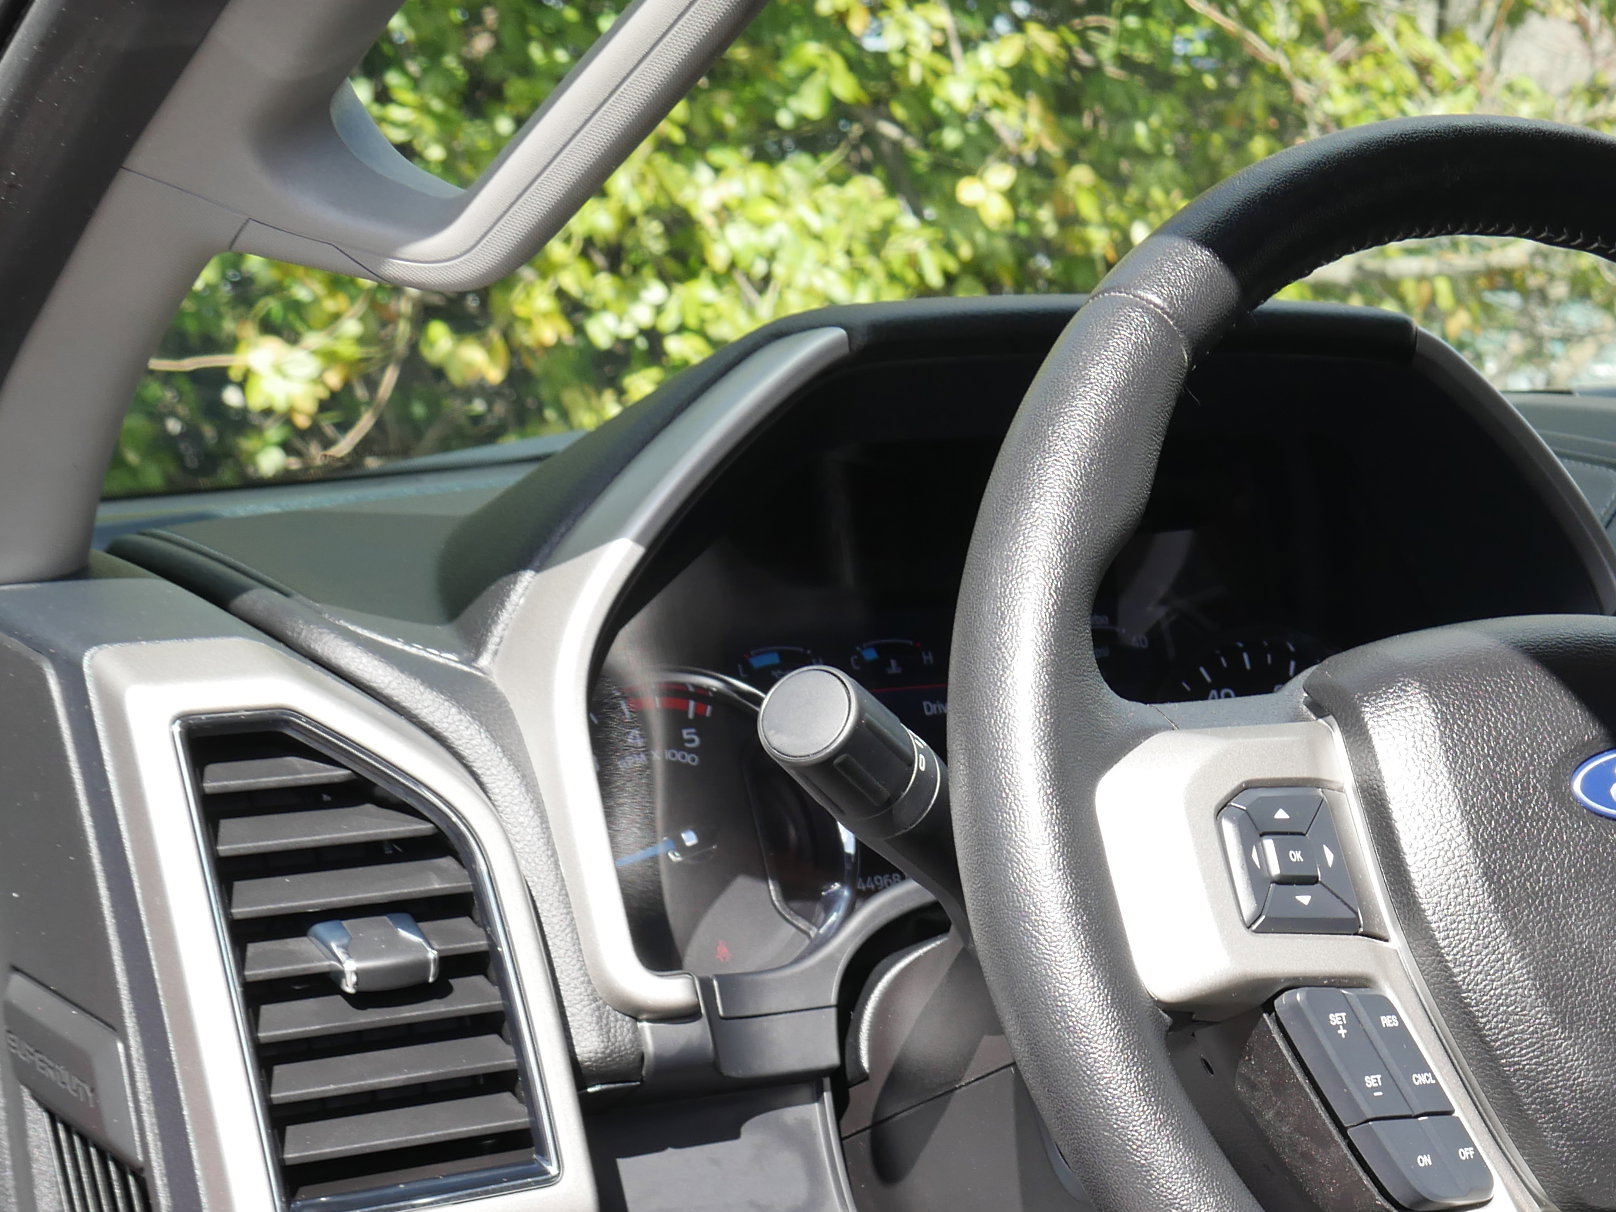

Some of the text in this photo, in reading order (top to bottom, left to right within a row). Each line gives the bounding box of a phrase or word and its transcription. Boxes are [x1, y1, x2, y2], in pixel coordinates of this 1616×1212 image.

[681, 728, 701, 748] 5
[664, 749, 700, 766] 1000
[1288, 850, 1304, 863] OK
[1328, 1012, 1347, 1026] SET
[1380, 1015, 1399, 1028] RES
[1364, 1075, 1382, 1088] SET
[1412, 1072, 1436, 1086] CNCL
[1458, 1147, 1475, 1160] OFF
[1416, 1154, 1432, 1168] ON
